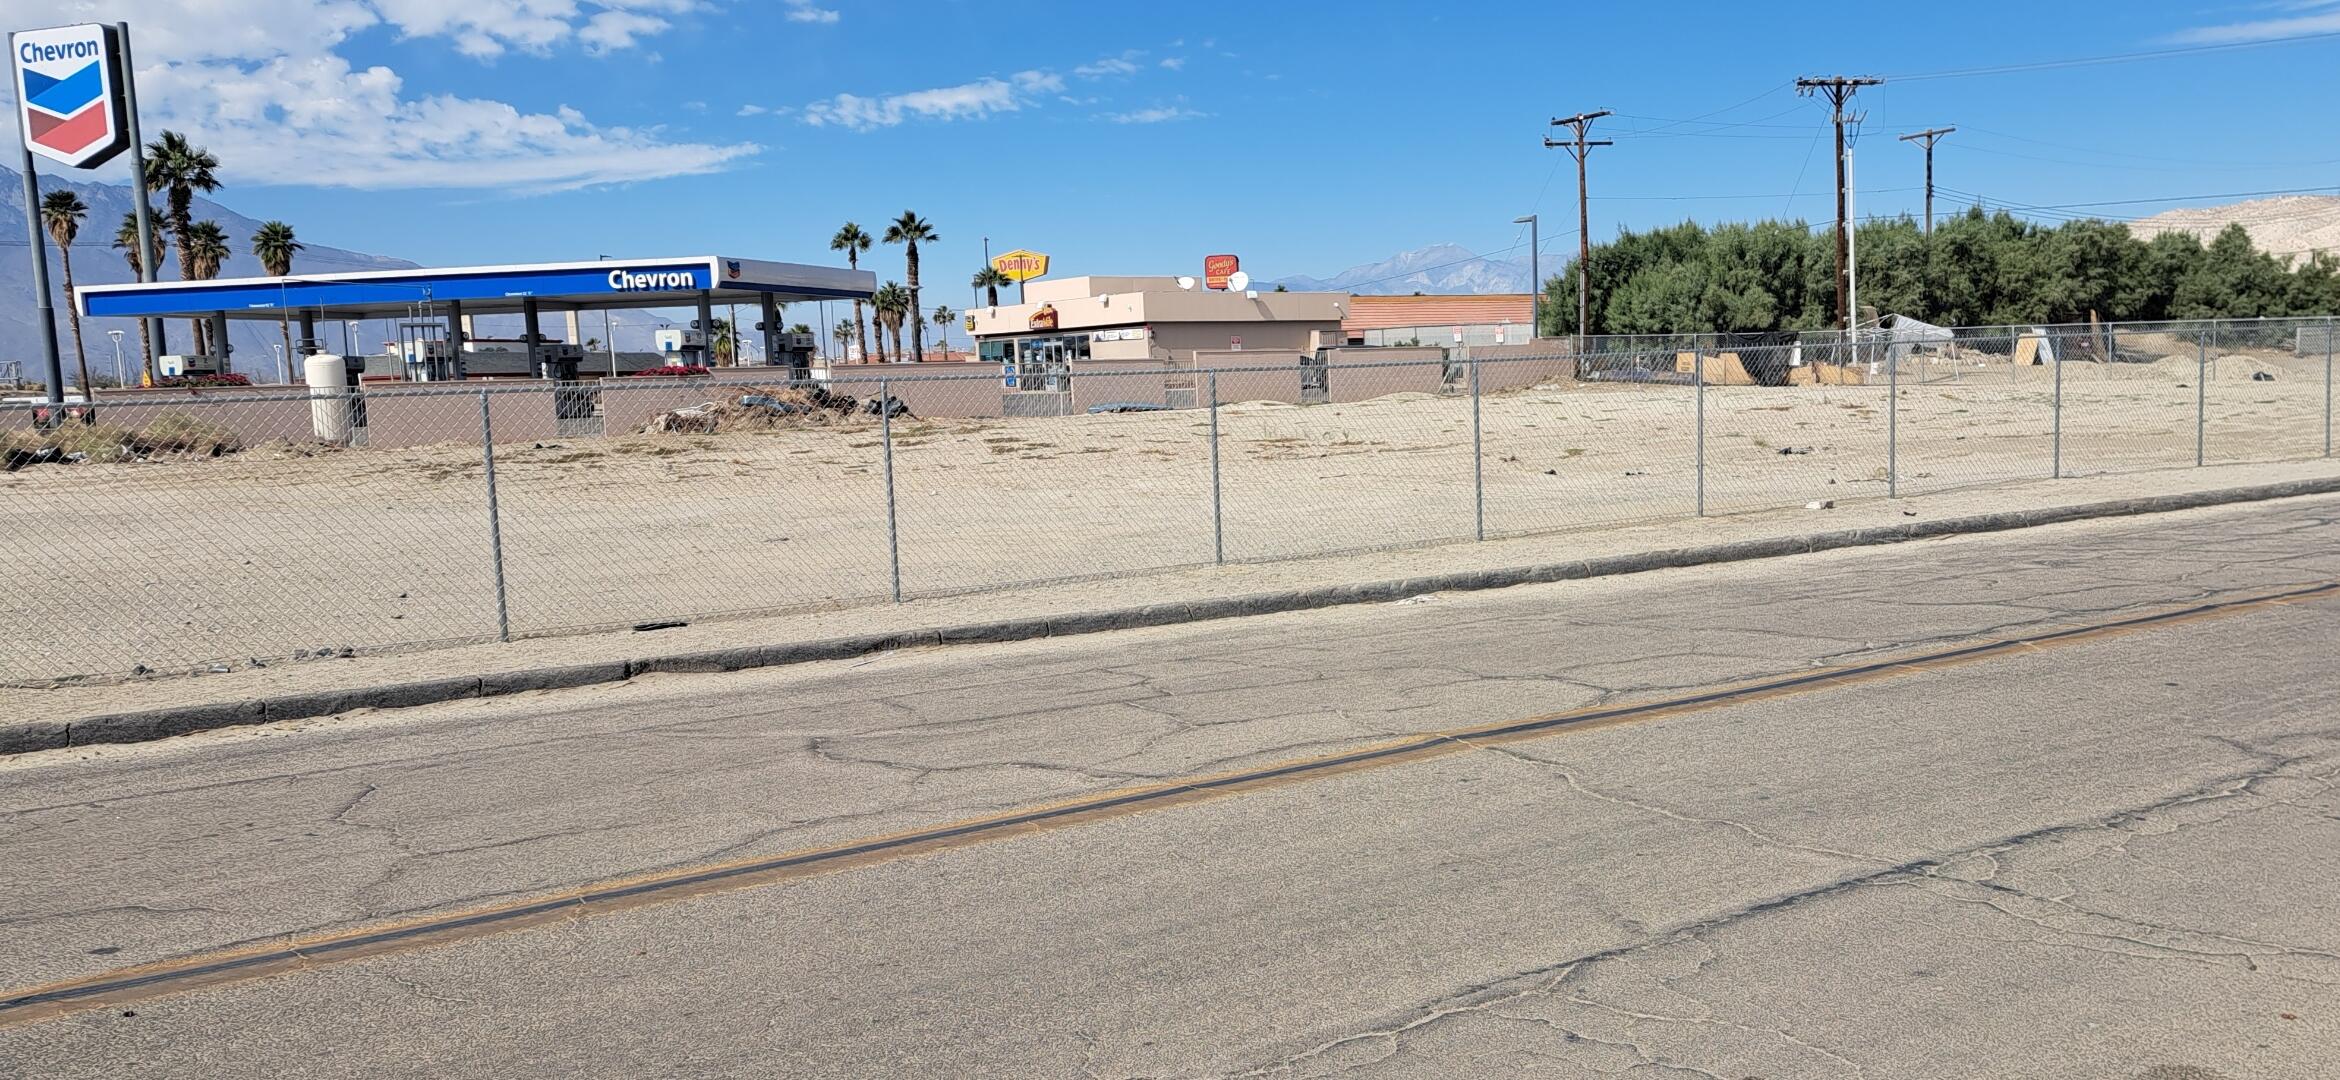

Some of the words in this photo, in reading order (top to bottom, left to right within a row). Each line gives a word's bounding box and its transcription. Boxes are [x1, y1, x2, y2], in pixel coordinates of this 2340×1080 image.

[20, 40, 98, 63] Chevron
[999, 257, 1040, 273] Denny's
[1208, 259, 1234, 272] Goody's
[608, 269, 693, 289] Chevron
